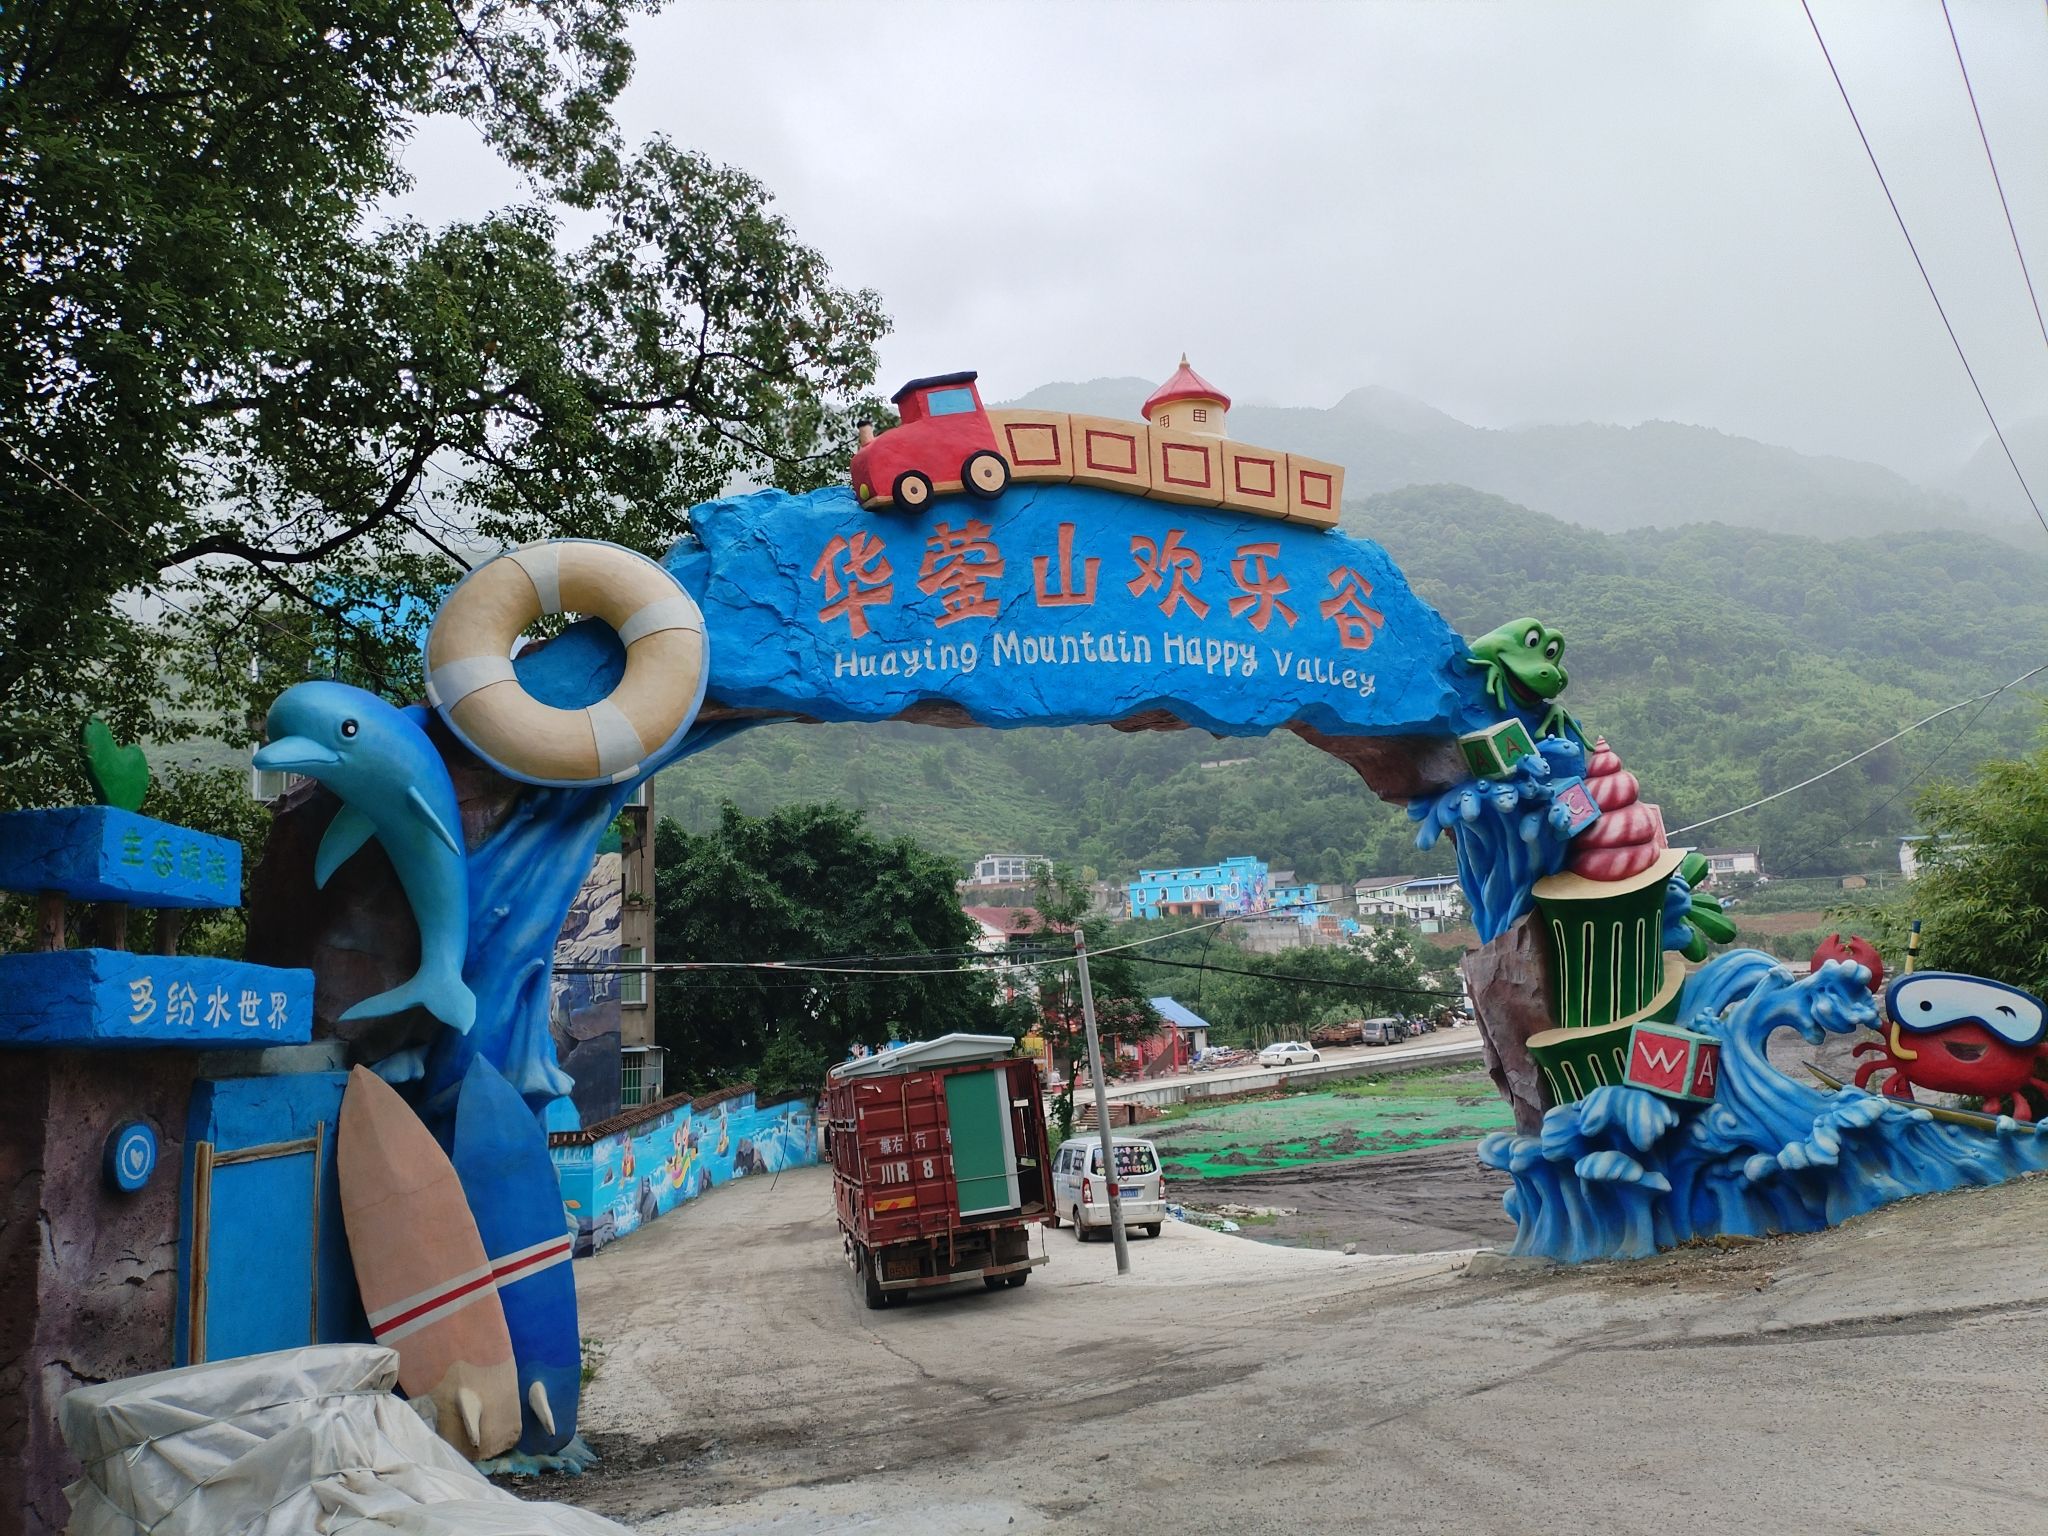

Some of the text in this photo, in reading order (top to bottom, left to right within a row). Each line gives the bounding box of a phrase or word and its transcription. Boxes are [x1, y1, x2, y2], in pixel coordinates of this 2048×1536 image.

[810, 519, 1385, 651] 华蓥山欢乐谷
[834, 630, 1377, 698] Huaying Mountain Happy Valley
[1506, 736, 1523, 759] A
[1638, 1041, 1685, 1074] W
[1697, 1050, 1714, 1086] A
